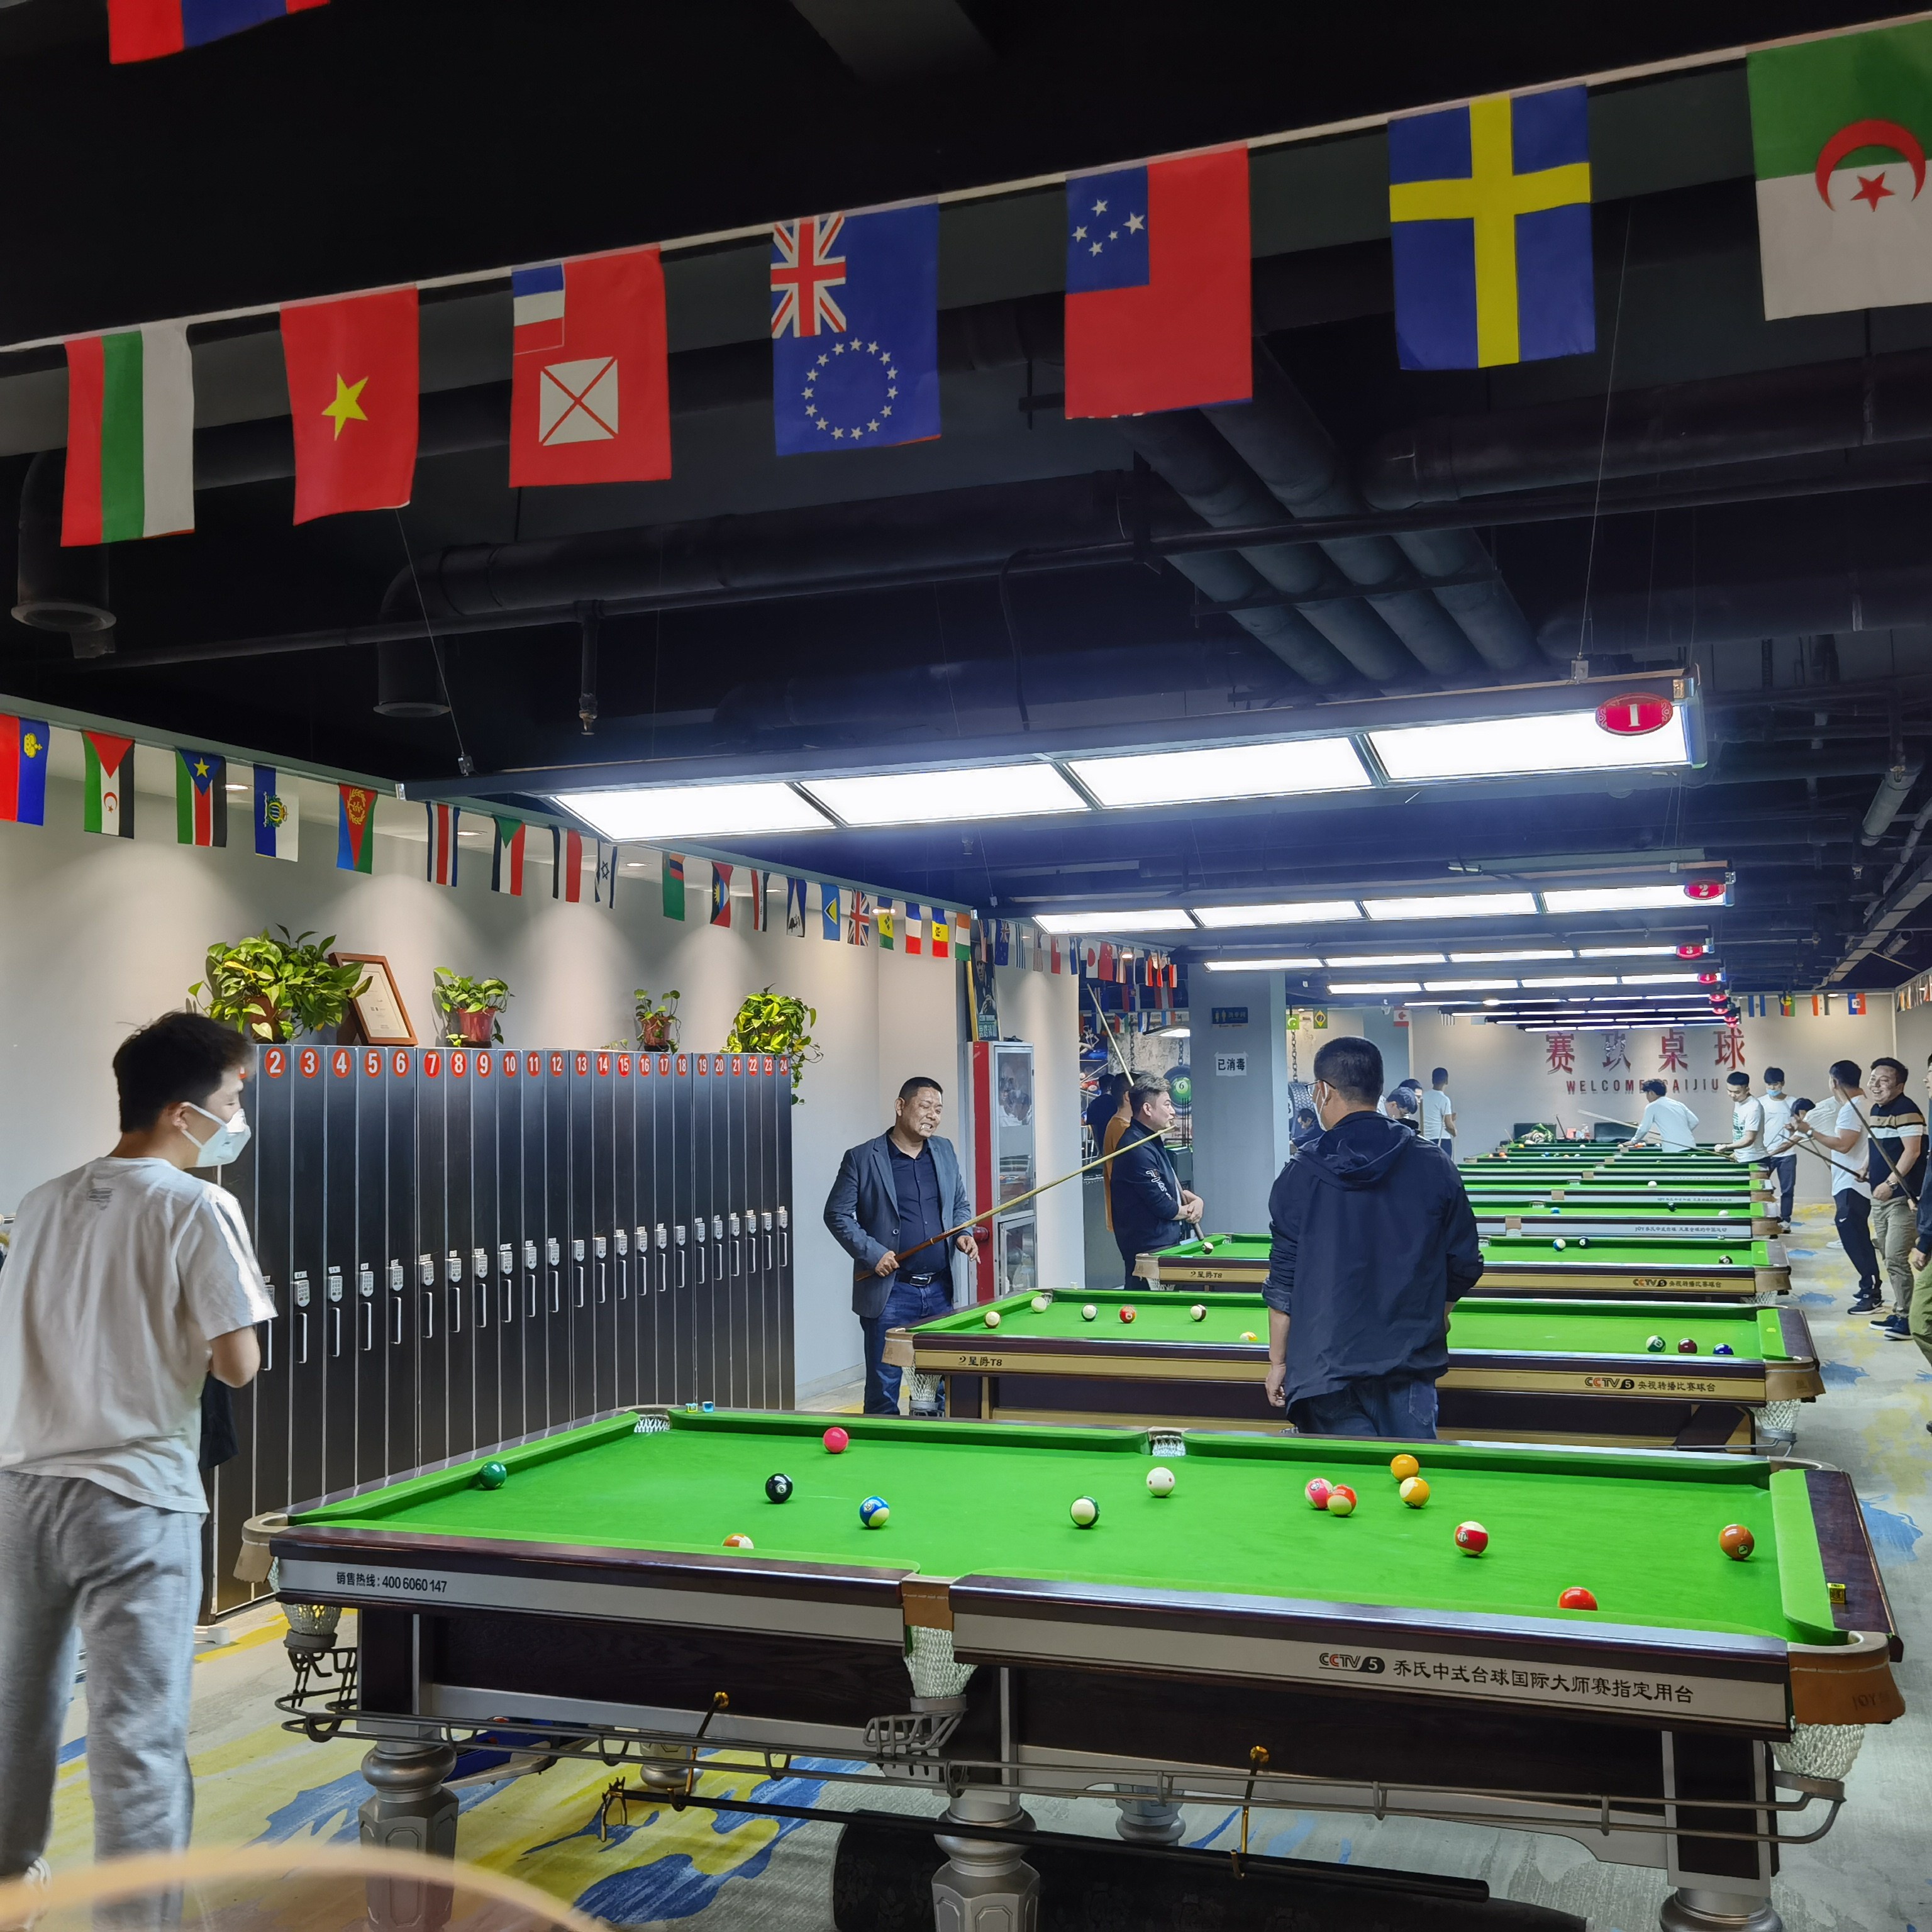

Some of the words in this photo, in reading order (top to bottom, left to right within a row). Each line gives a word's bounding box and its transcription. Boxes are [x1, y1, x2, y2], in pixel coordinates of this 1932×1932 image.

[1699, 884, 1709, 896] 2
[270, 1051, 281, 1074] 2
[304, 1052, 315, 1074] 3
[336, 1052, 347, 1073] 4
[368, 1053, 378, 1074] 5
[396, 1052, 406, 1073] 6
[428, 1053, 436, 1074] 7
[454, 1053, 464, 1073] 8
[479, 1054, 489, 1074] 9
[505, 1056, 516, 1072] 10
[529, 1056, 539, 1072] 11
[552, 1056, 562, 1072] 12
[577, 1057, 587, 1072] 13
[599, 1057, 609, 1072] 14
[619, 1057, 630, 1072] 15
[640, 1058, 650, 1072] 16
[660, 1058, 669, 1072] 17
[678, 1058, 686, 1072] 18
[699, 1058, 708, 1072] 19
[715, 1059, 724, 1072] 20
[733, 1059, 741, 1072] 21
[748, 1058, 757, 1072] 22
[765, 1059, 773, 1072] 23
[780, 1059, 788, 1072] 24
[1218, 1058, 1245, 1071] 已消毒
[1566, 1079, 1645, 1094] WELCOME
[1665, 1079, 1719, 1092] AIJIU
[1638, 1380, 1716, 1392] 央视转播比赛球台
[1392, 1659, 1694, 1704] 乔氏中式台球国际大师赛指定用台
